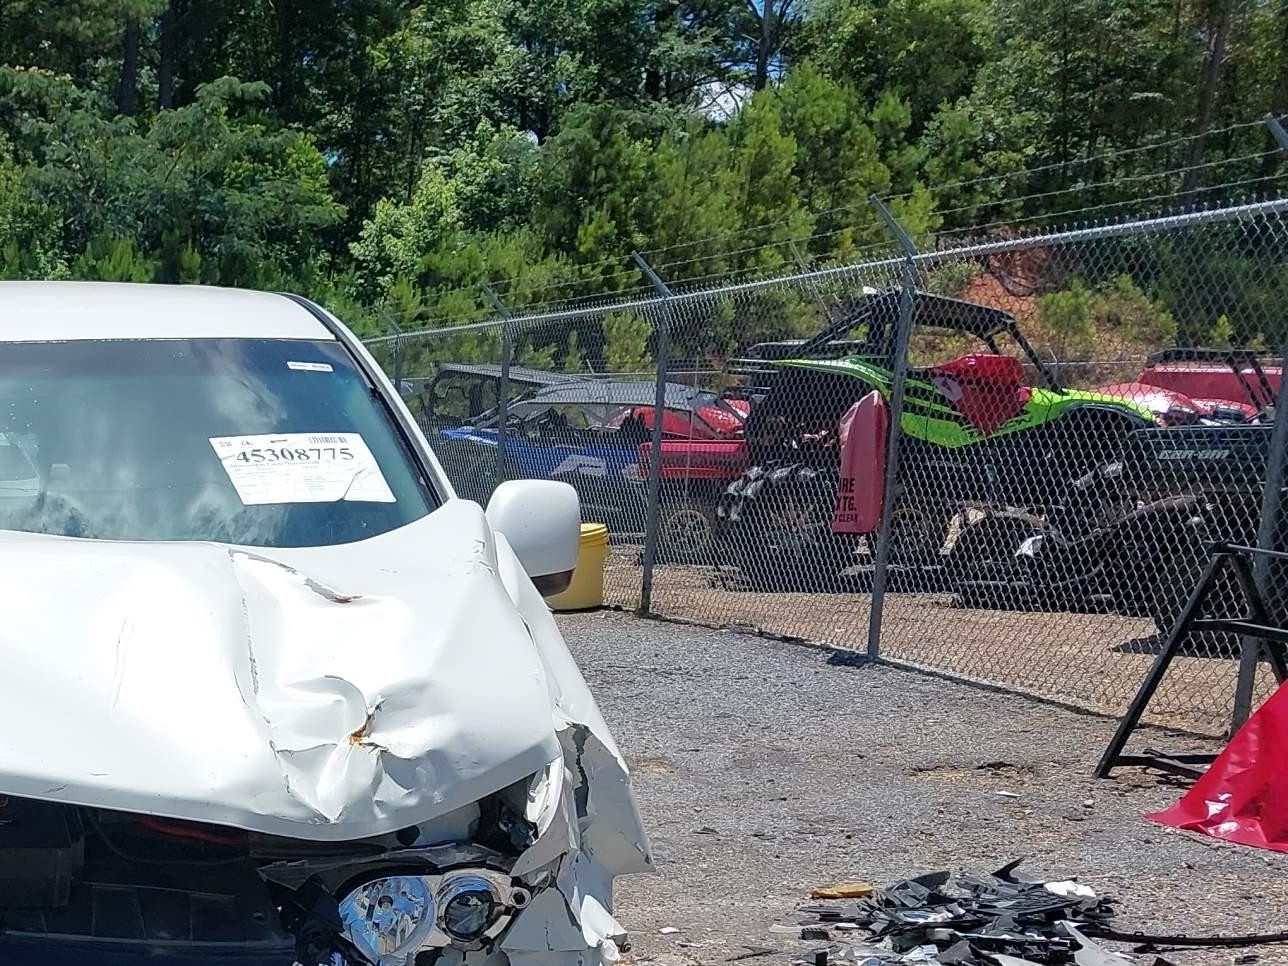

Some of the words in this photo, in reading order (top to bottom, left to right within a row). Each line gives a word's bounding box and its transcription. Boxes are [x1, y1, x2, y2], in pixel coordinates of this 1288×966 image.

[236, 447, 355, 463] 45308775
[839, 478, 855, 492] IRE
[836, 496, 857, 511] XTG.
